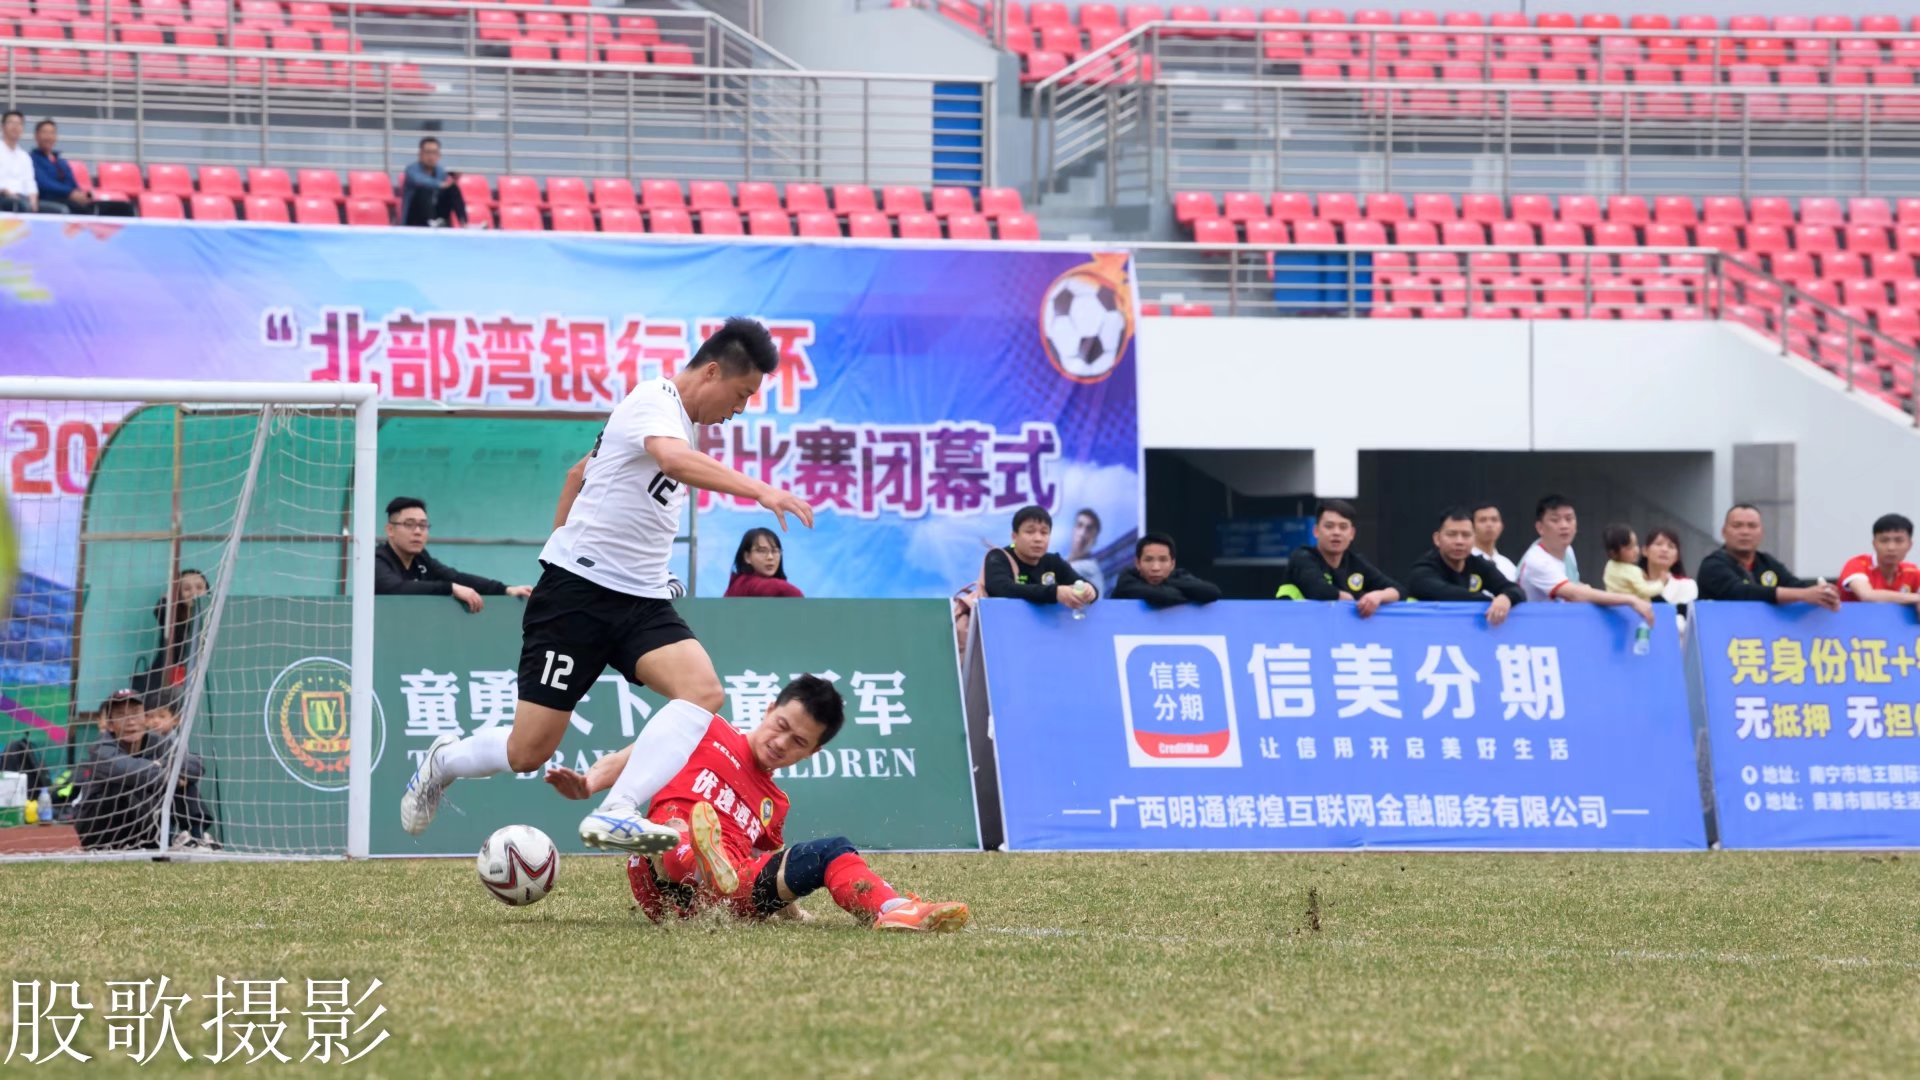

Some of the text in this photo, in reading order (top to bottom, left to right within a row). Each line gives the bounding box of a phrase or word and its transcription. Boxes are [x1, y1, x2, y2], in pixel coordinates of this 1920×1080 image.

[10, 419, 116, 494] 20
[540, 650, 575, 691] 12
[1149, 662, 1200, 690] 信美
[1247, 643, 1566, 721] 信美分期
[1727, 637, 1920, 685] 凭身份证+
[1153, 694, 1204, 721] 分期
[1735, 696, 1920, 739] 无抵押 无担
